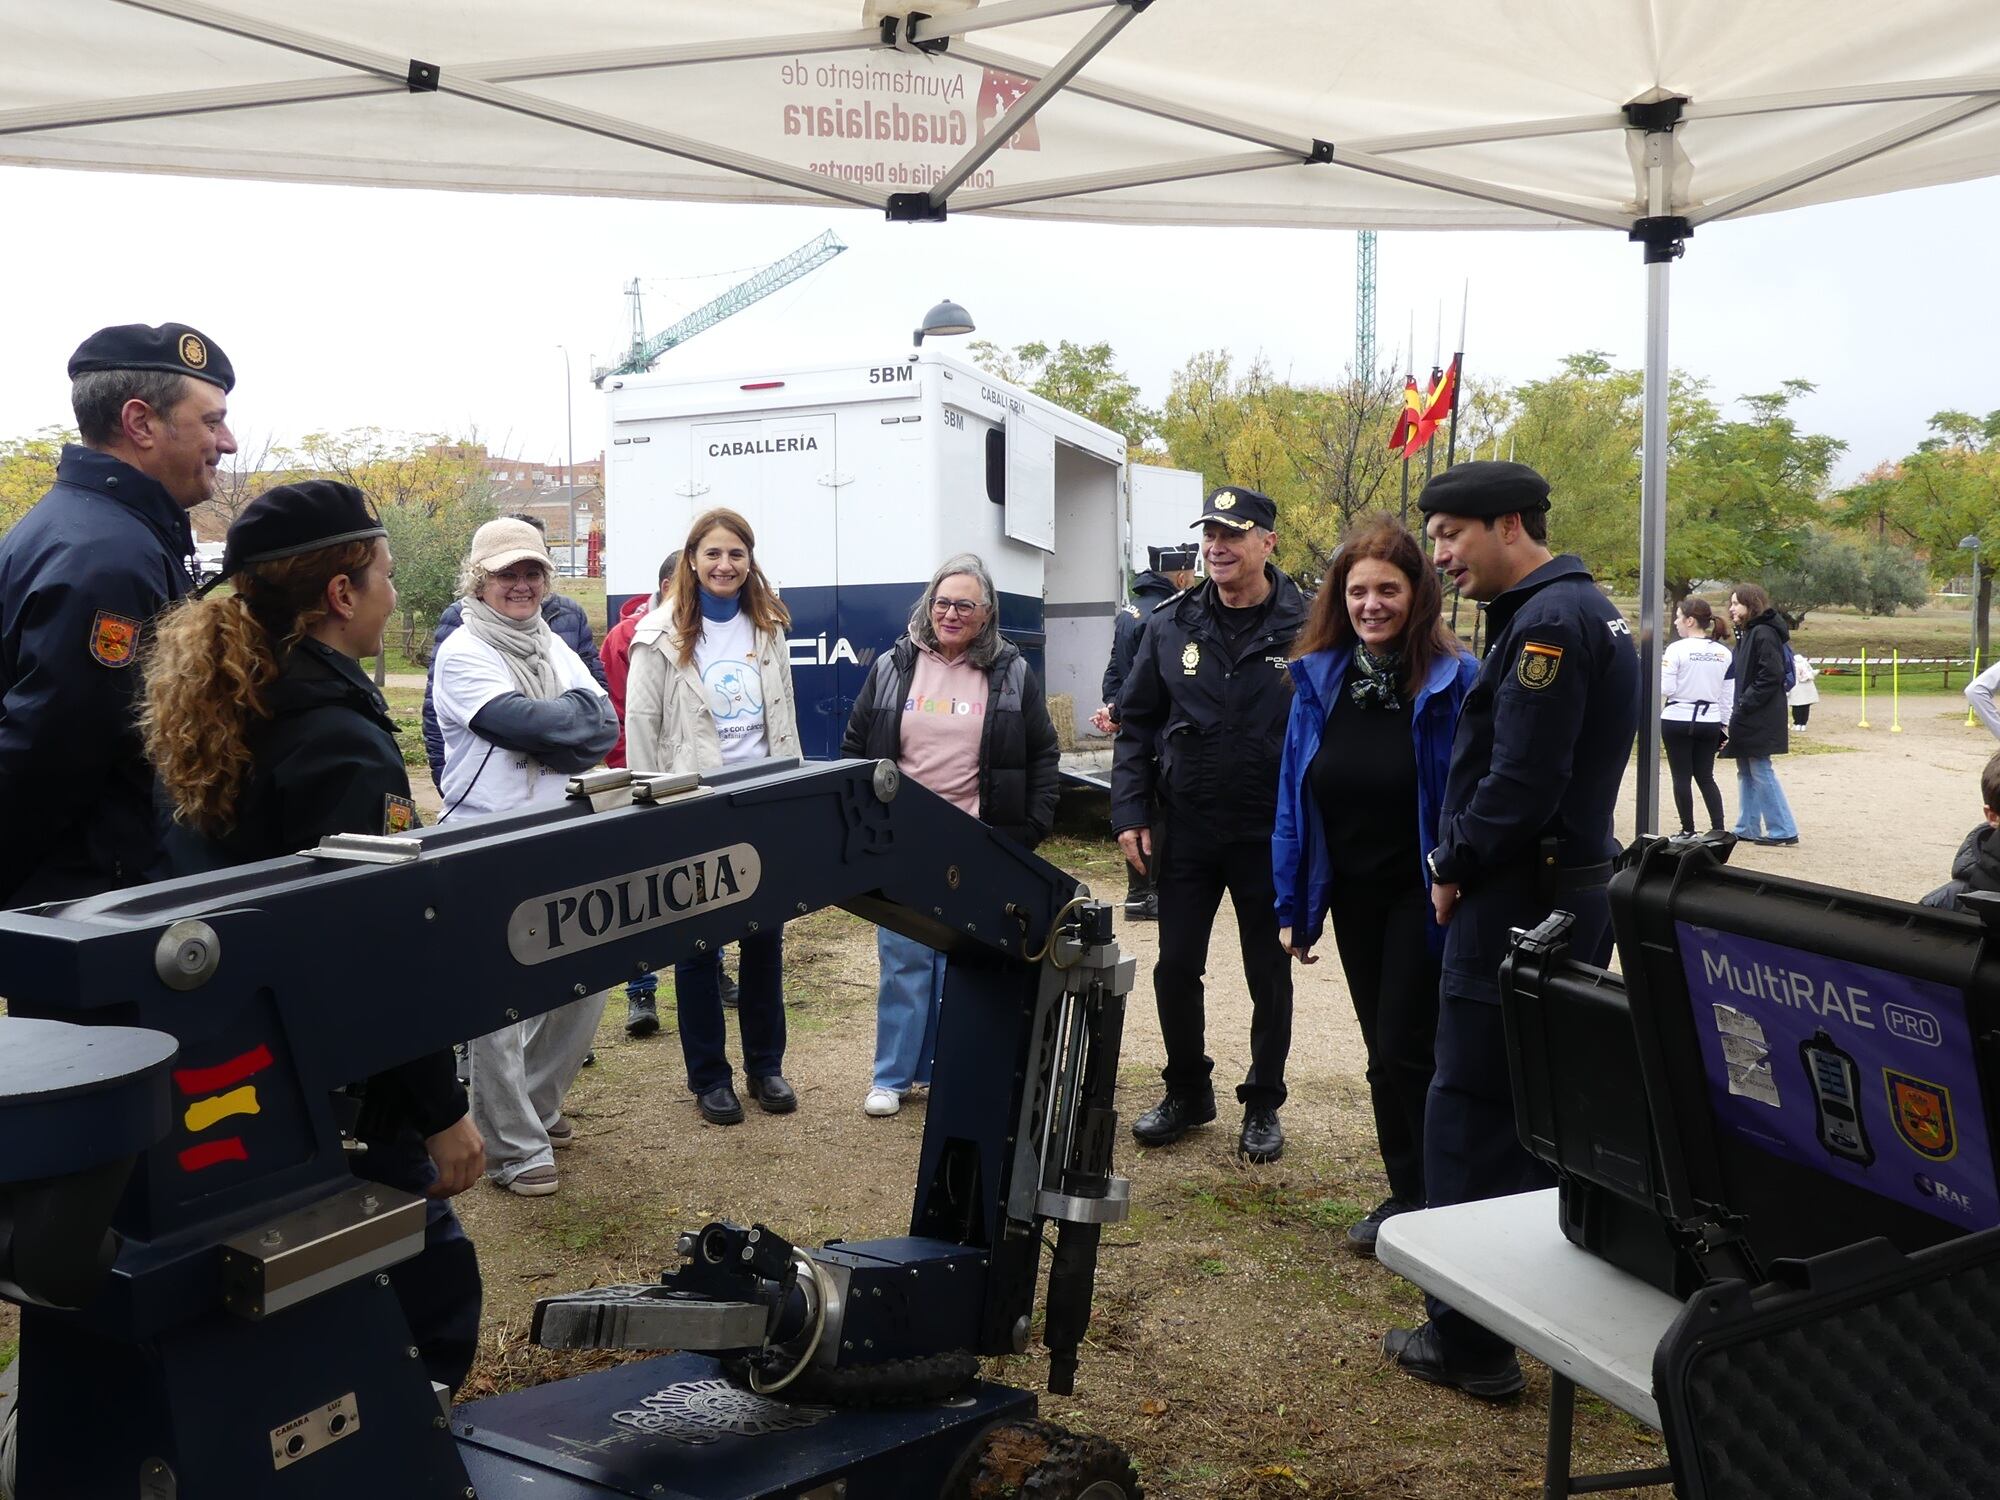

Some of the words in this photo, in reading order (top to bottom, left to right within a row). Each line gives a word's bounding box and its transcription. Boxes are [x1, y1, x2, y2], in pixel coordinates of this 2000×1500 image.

[869, 365, 913, 384] 5BM
[944, 409, 964, 431] 5BM
[709, 434, 818, 457] CABALLERÍA
[1607, 618, 1630, 637] PO
[785, 631, 859, 666] CÍA
[545, 854, 740, 950] POLICIA
[1701, 949, 1876, 1030] MultiRAE
[1891, 1010, 1935, 1039] PRO
[1935, 1181, 1970, 1209] RAE
[327, 1400, 343, 1412] LUZ
[275, 1416, 310, 1437] CAMARA
